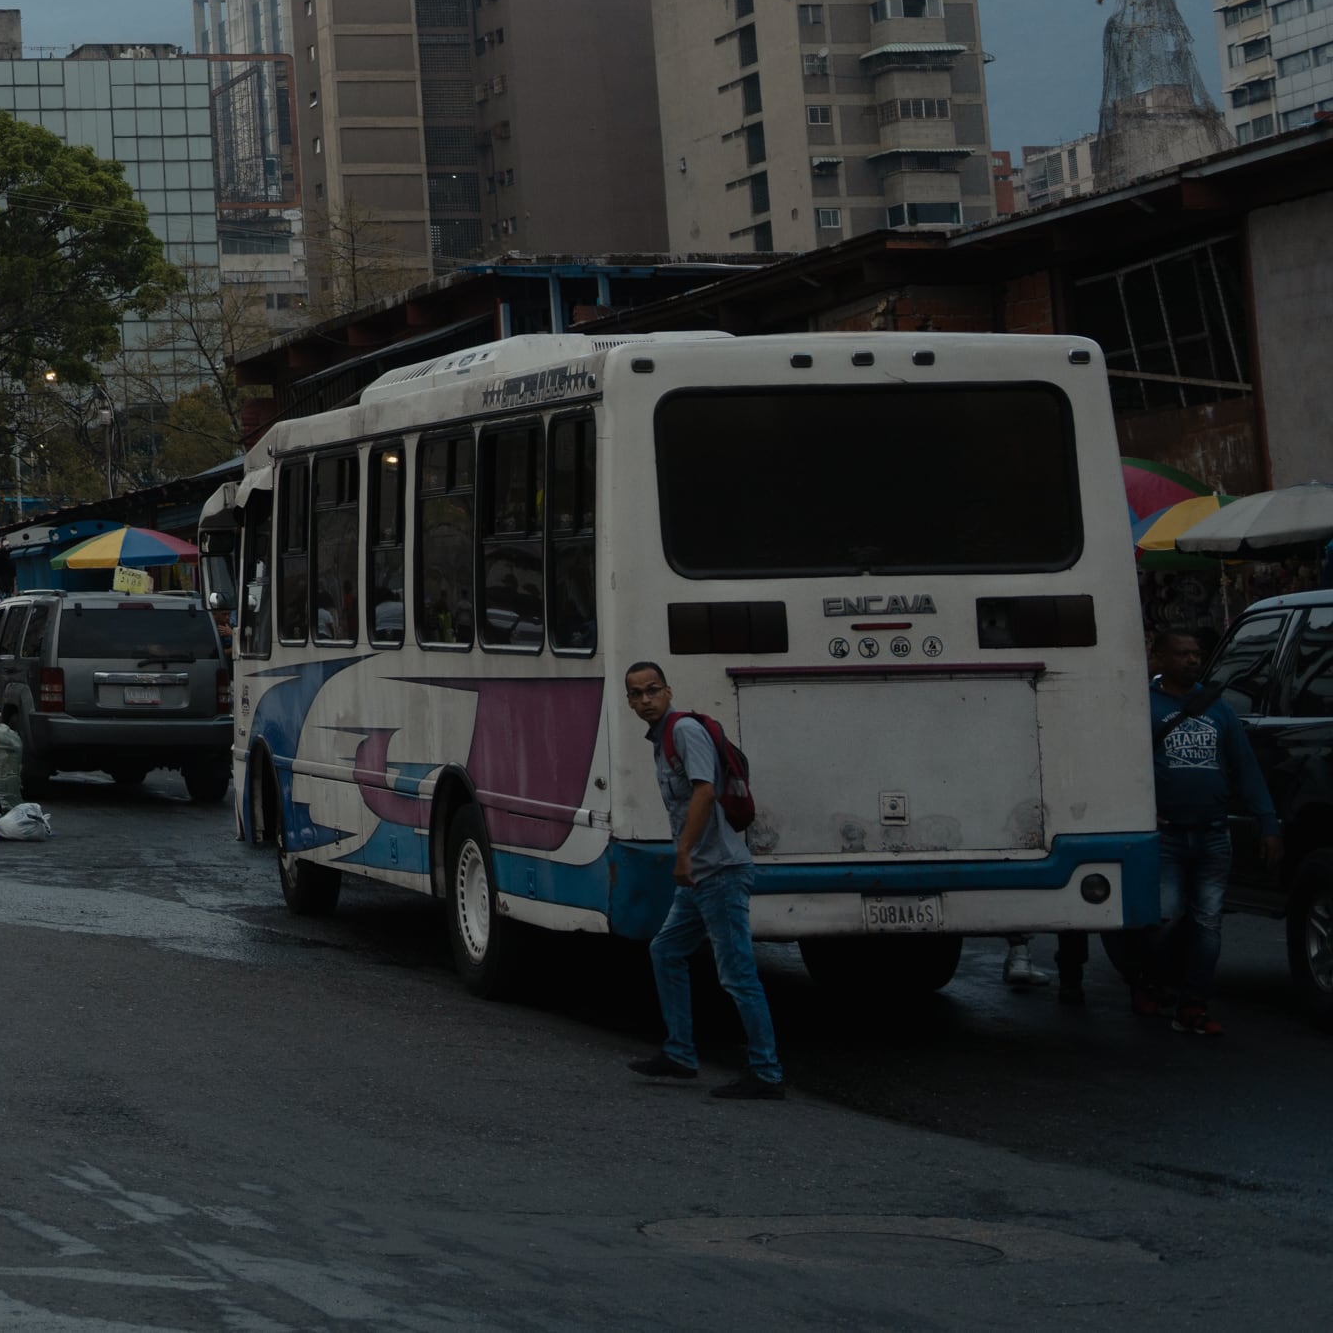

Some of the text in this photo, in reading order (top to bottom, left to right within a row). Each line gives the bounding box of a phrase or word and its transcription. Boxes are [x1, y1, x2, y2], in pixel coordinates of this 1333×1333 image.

[822, 594, 937, 617] ENCAVA
[893, 643, 909, 654] 80
[1164, 733, 1217, 750] CHAMPS
[869, 905, 934, 924] 508AA6S
